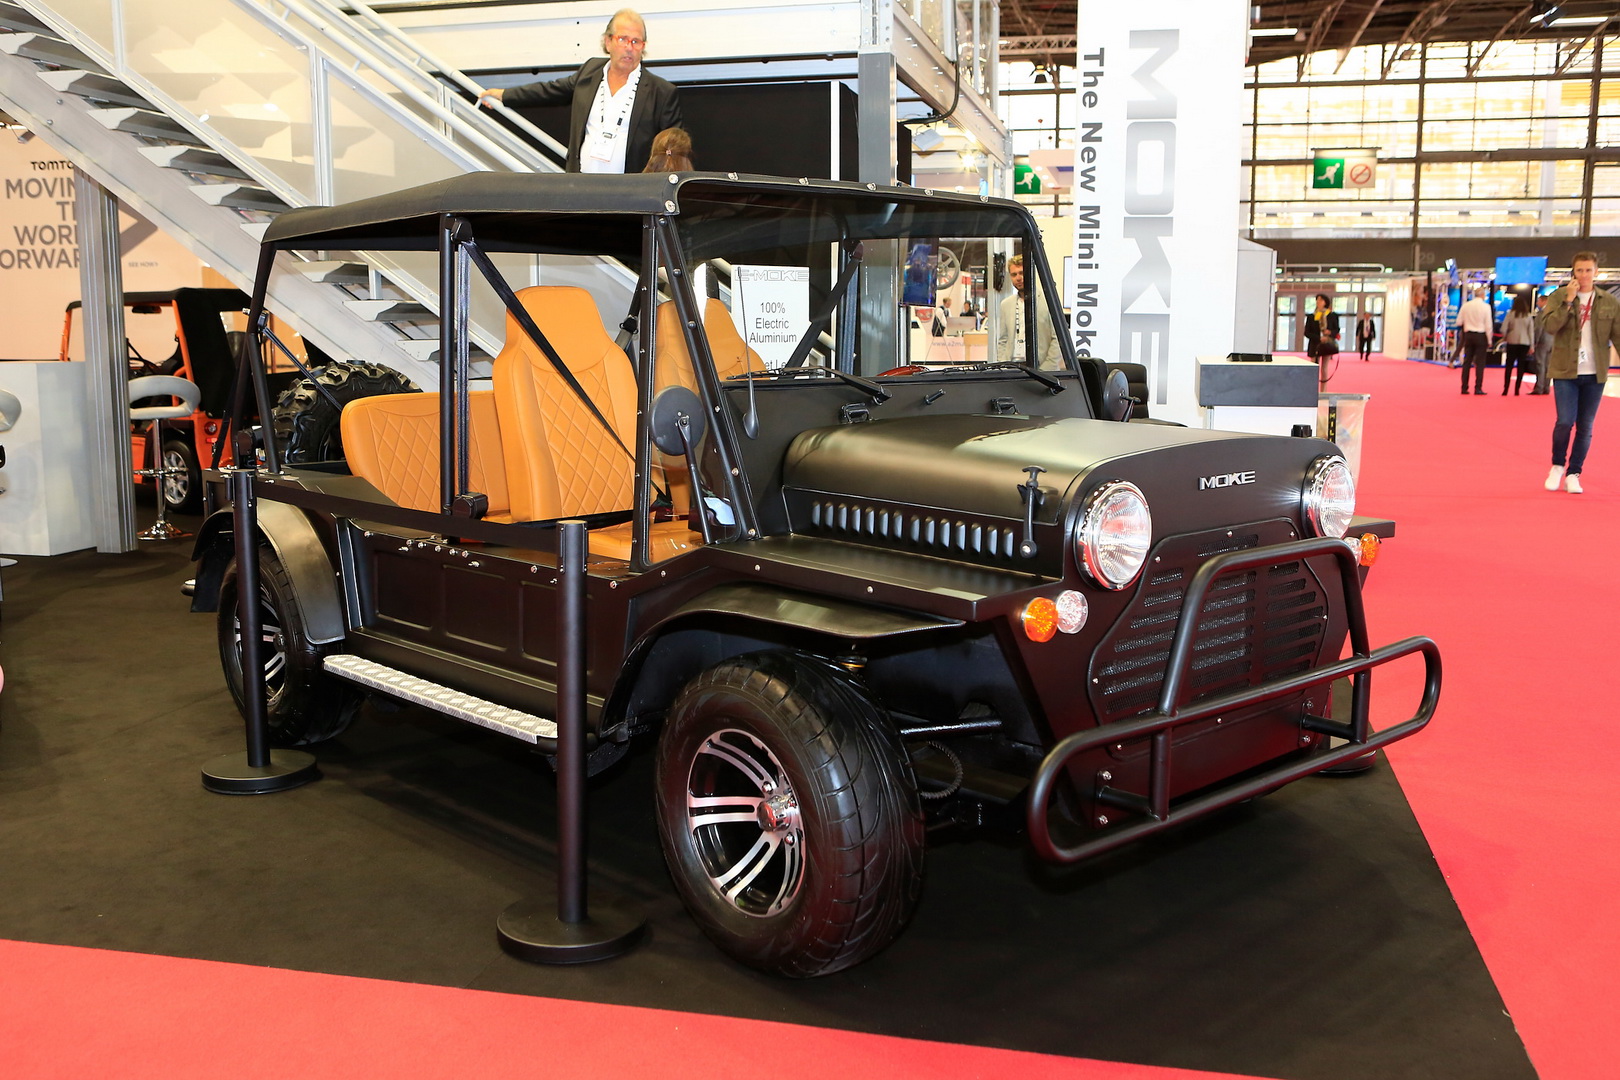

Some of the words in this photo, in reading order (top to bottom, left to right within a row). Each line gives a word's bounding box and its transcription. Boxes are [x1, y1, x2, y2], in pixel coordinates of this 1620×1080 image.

[1082, 47, 1105, 108] The
[1080, 122, 1103, 192] New
[1119, 29, 1180, 405] MOKE
[1077, 205, 1101, 269] Mini
[735, 269, 809, 281] E-MOKE
[760, 302, 786, 314] 100%
[755, 317, 790, 329] Electric
[749, 332, 797, 343] Aluminium
[1198, 470, 1256, 491] MOKE
